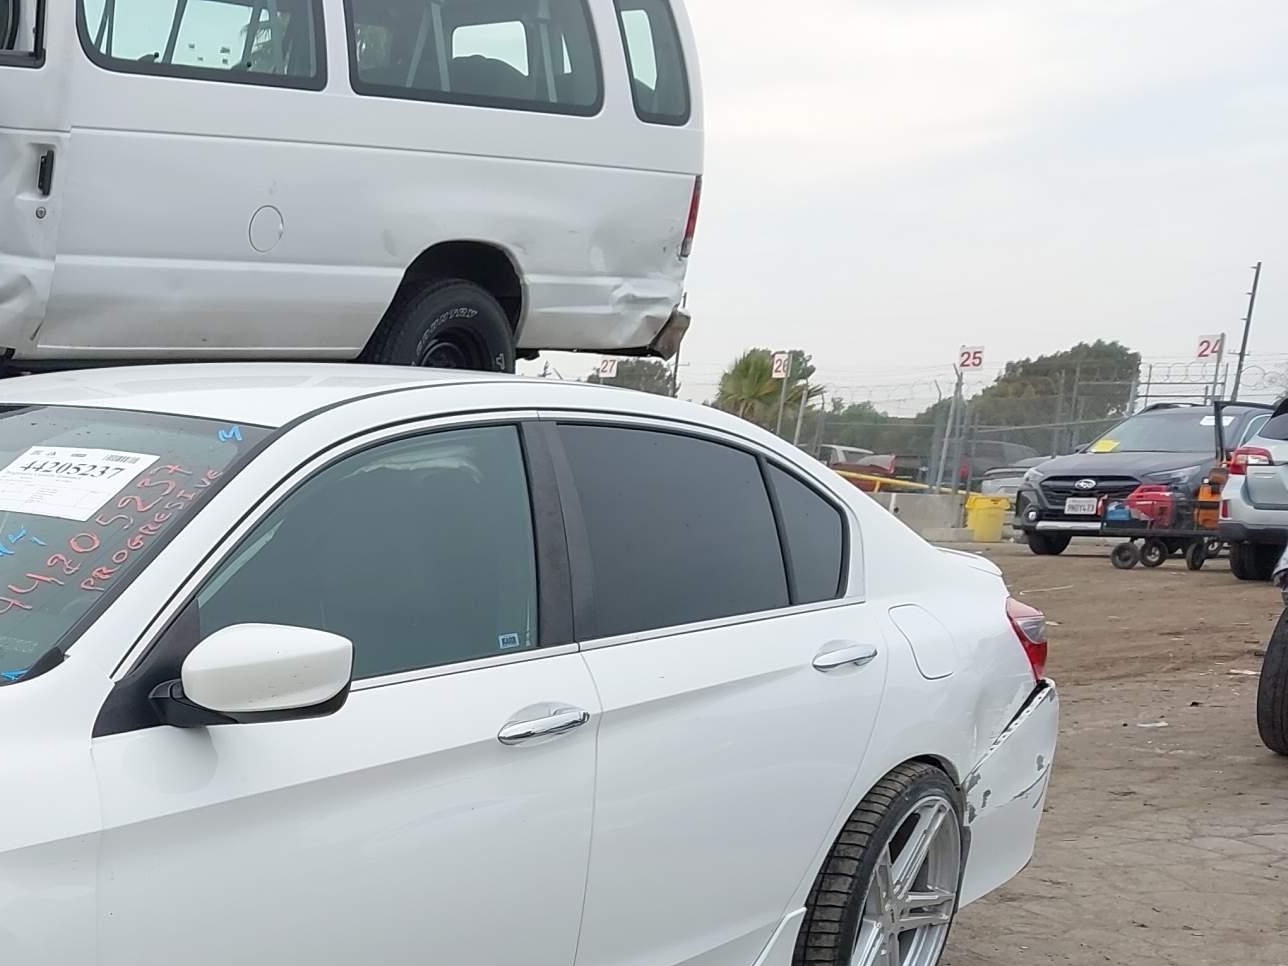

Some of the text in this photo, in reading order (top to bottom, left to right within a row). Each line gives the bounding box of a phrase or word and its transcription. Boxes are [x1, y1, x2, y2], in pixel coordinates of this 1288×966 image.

[600, 359, 616, 373] 27
[959, 351, 983, 367] 25
[20, 460, 126, 480] 44205237
